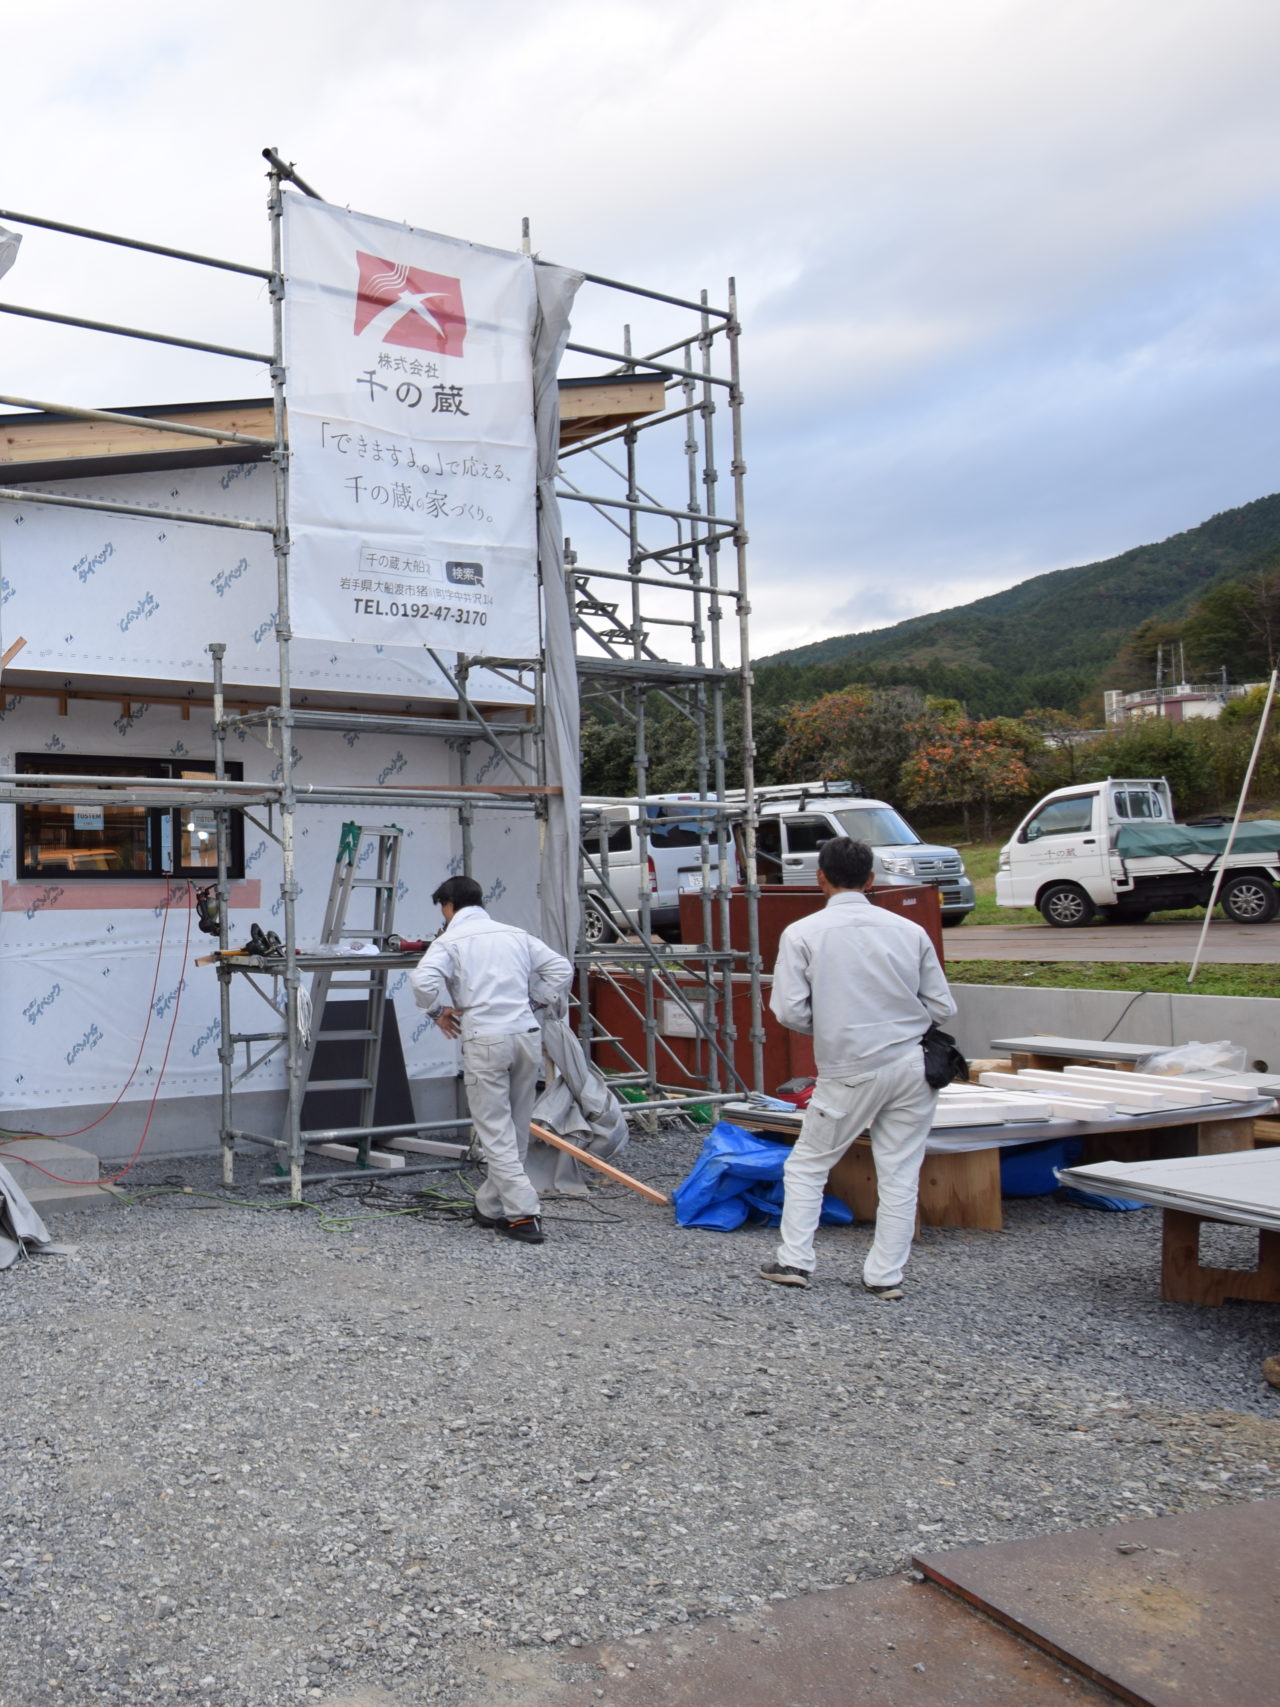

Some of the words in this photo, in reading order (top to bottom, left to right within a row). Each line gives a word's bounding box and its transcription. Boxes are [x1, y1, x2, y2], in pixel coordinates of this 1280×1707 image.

[377, 352, 440, 379] 株式会社
[356, 369, 470, 416] 千の蔵
[452, 567, 475, 581] 検索
[354, 598, 487, 626] TEL.0192-47-3170
